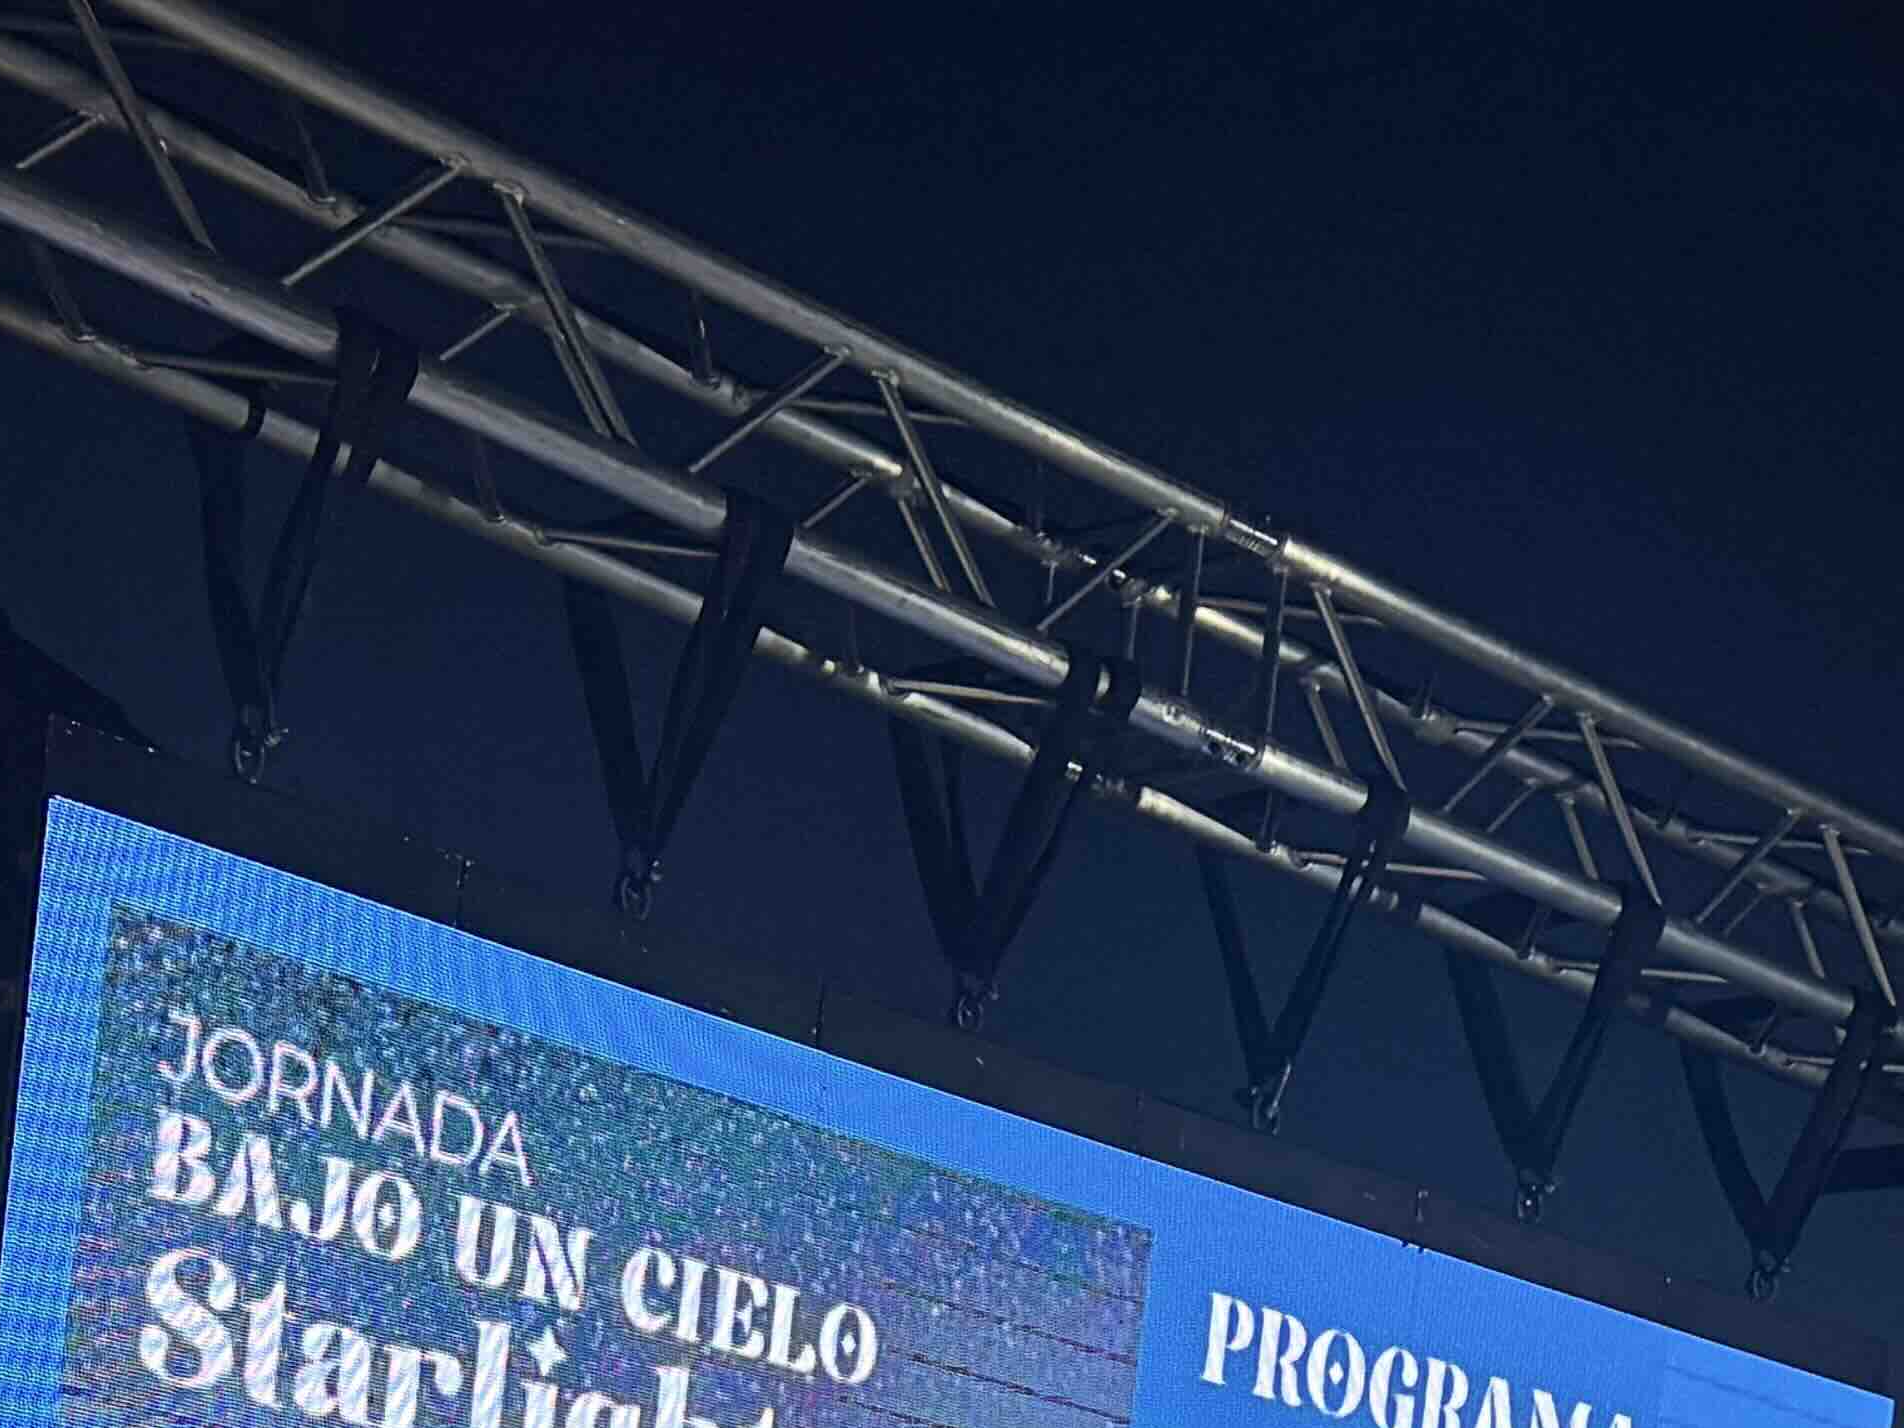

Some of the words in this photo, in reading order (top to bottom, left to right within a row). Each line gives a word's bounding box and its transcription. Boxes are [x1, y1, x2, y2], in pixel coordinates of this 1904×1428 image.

[156, 1006, 535, 1186] JORNADA
[152, 1104, 426, 1262] BAJO
[453, 1193, 594, 1314] UN
[621, 1243, 881, 1386] CIELO
